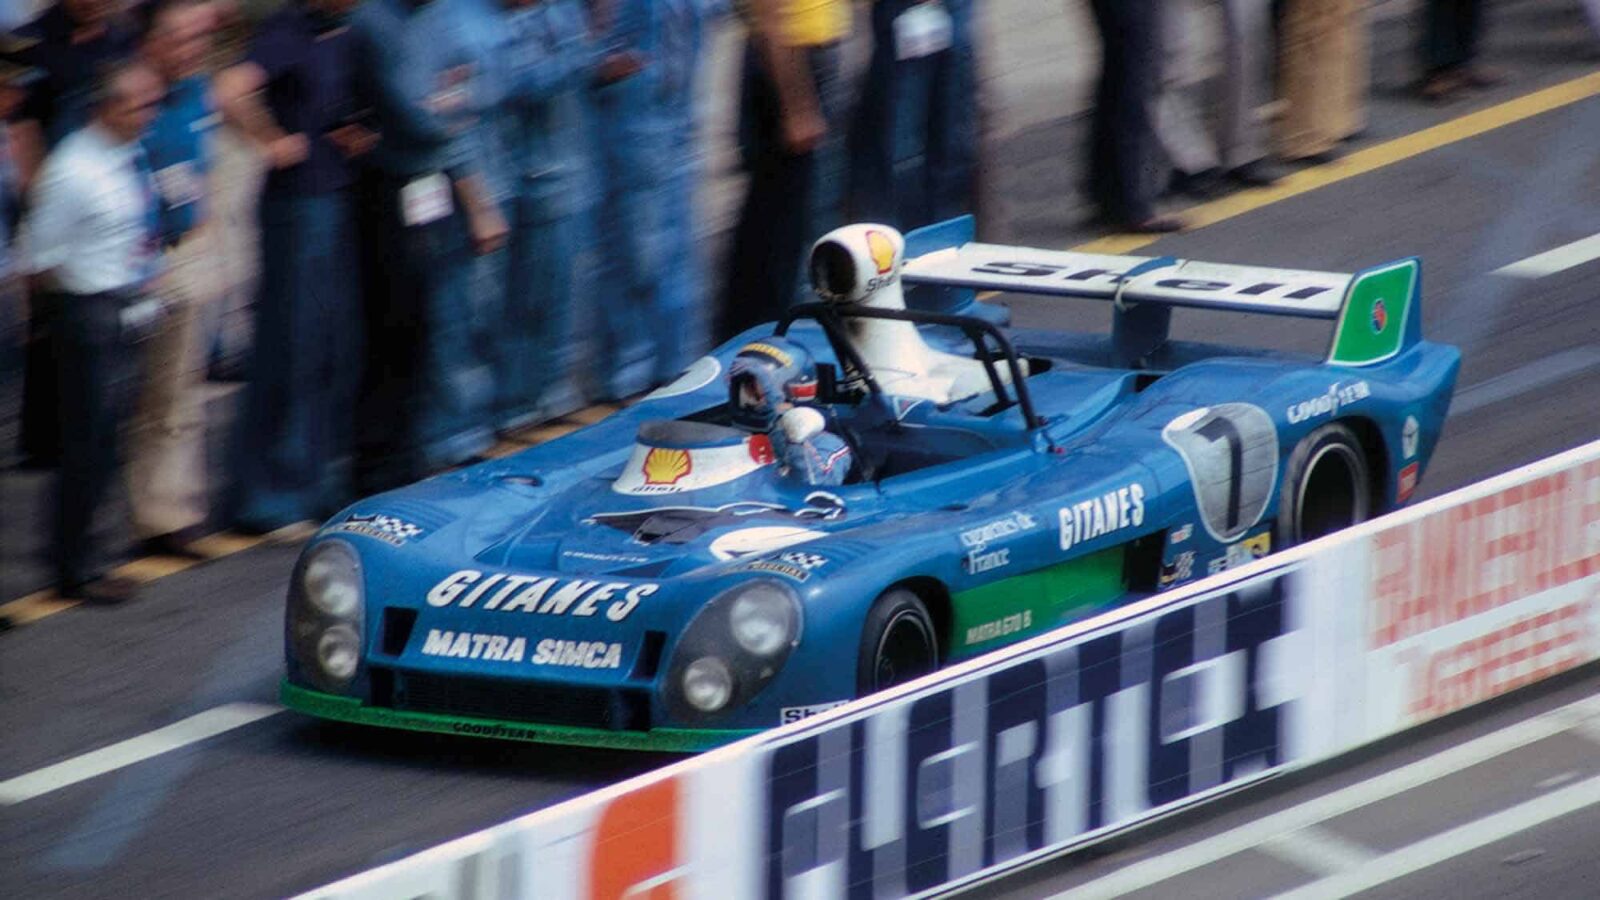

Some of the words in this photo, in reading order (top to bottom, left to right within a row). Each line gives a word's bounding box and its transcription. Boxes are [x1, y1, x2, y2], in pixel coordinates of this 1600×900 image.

[1058, 483, 1146, 551] GITANES
[426, 569, 661, 622] GITANES
[421, 628, 528, 663] MATRA
[531, 638, 623, 669] SIMCA
